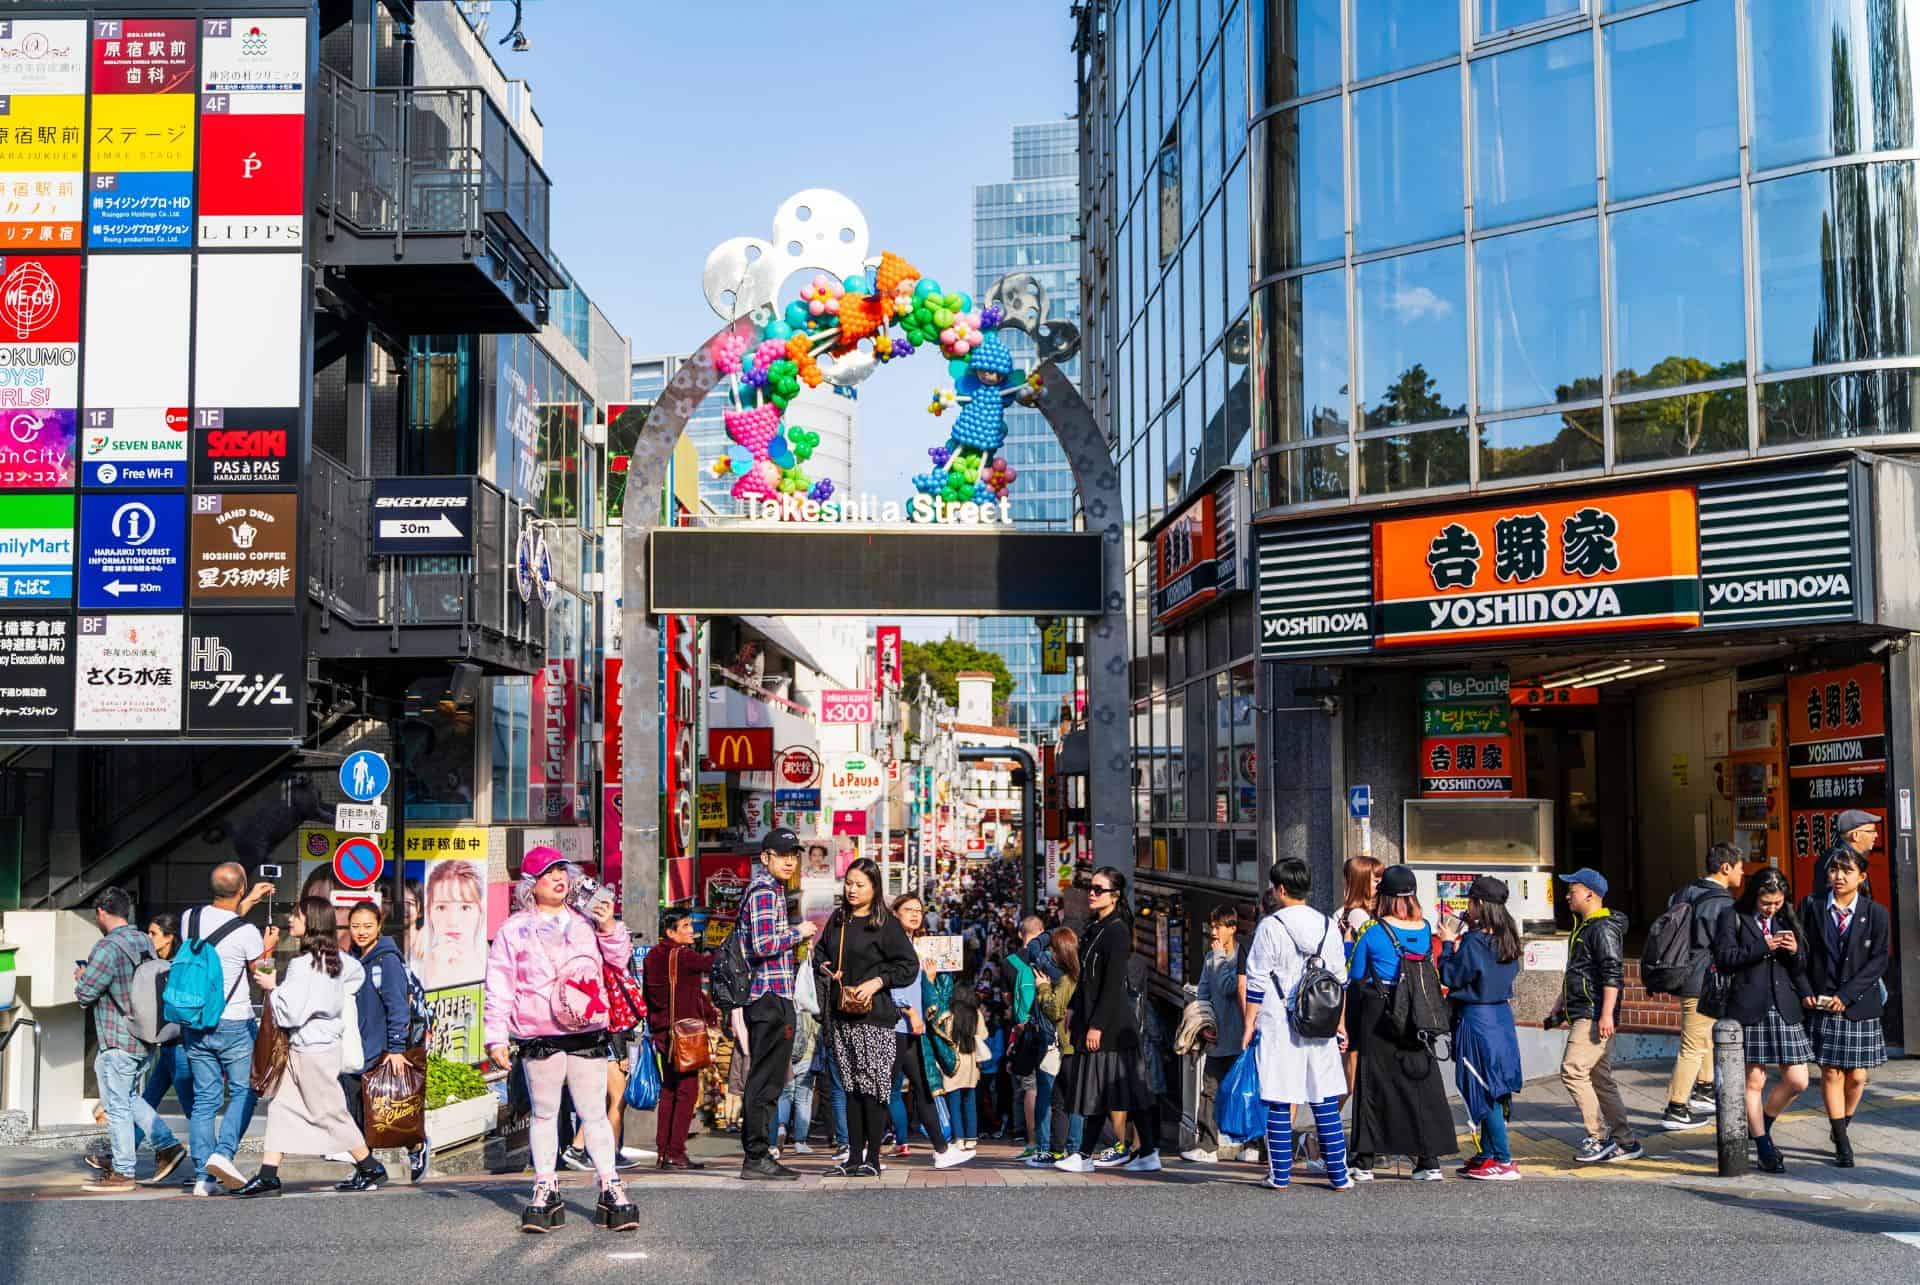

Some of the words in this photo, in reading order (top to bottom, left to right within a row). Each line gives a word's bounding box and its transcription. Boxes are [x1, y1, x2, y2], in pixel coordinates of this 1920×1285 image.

[99, 22, 118, 37] 7F
[207, 20, 227, 35] 7F
[104, 40, 186, 57] 原宿駅前
[127, 67, 164, 84] 歯科
[206, 97, 226, 111] 4F
[97, 125, 187, 144] ステージ
[96, 176, 114, 188] 5F
[202, 226, 300, 239] LIPPS
[90, 411, 107, 426] 1F
[200, 410, 219, 426] 1F
[112, 440, 148, 450] SEVEN
[151, 440, 183, 450] BANK
[122, 468, 145, 479] Free
[147, 468, 173, 479] Wi-Fi
[214, 461, 240, 473] PAS
[253, 461, 280, 473] PAS
[198, 496, 216, 511] BF
[375, 496, 468, 508] SKECHERS
[741, 492, 904, 522] Takeshita
[911, 493, 1012, 524] Street
[216, 508, 247, 525] HAND
[249, 508, 275, 522] DRIP
[400, 524, 430, 534] 30m
[94, 548, 135, 556] HARAJUKU
[137, 548, 170, 556] TOURIST
[1426, 507, 1621, 590] 吉野家
[88, 557, 145, 565] INFORMATION
[146, 557, 177, 565] CENTER
[202, 552, 247, 561] HOSHINO
[249, 552, 287, 561] COFFEE
[198, 565, 290, 589] 星乃珈琲
[14, 579, 51, 595] たばこ
[83, 618, 102, 632] BF
[11, 653, 47, 665] Evacuation
[48, 653, 65, 665] Area
[191, 637, 232, 671] Hh
[87, 667, 172, 686] さくら水産
[208, 673, 293, 706] アッシュ
[825, 703, 869, 721] ¥300
[1430, 743, 1503, 772] 吉野家
[832, 772, 845, 787] La
[846, 772, 880, 788] Pausa
[1809, 776, 1865, 799] 2階席あります
[406, 838, 481, 851] 好評稼働中
